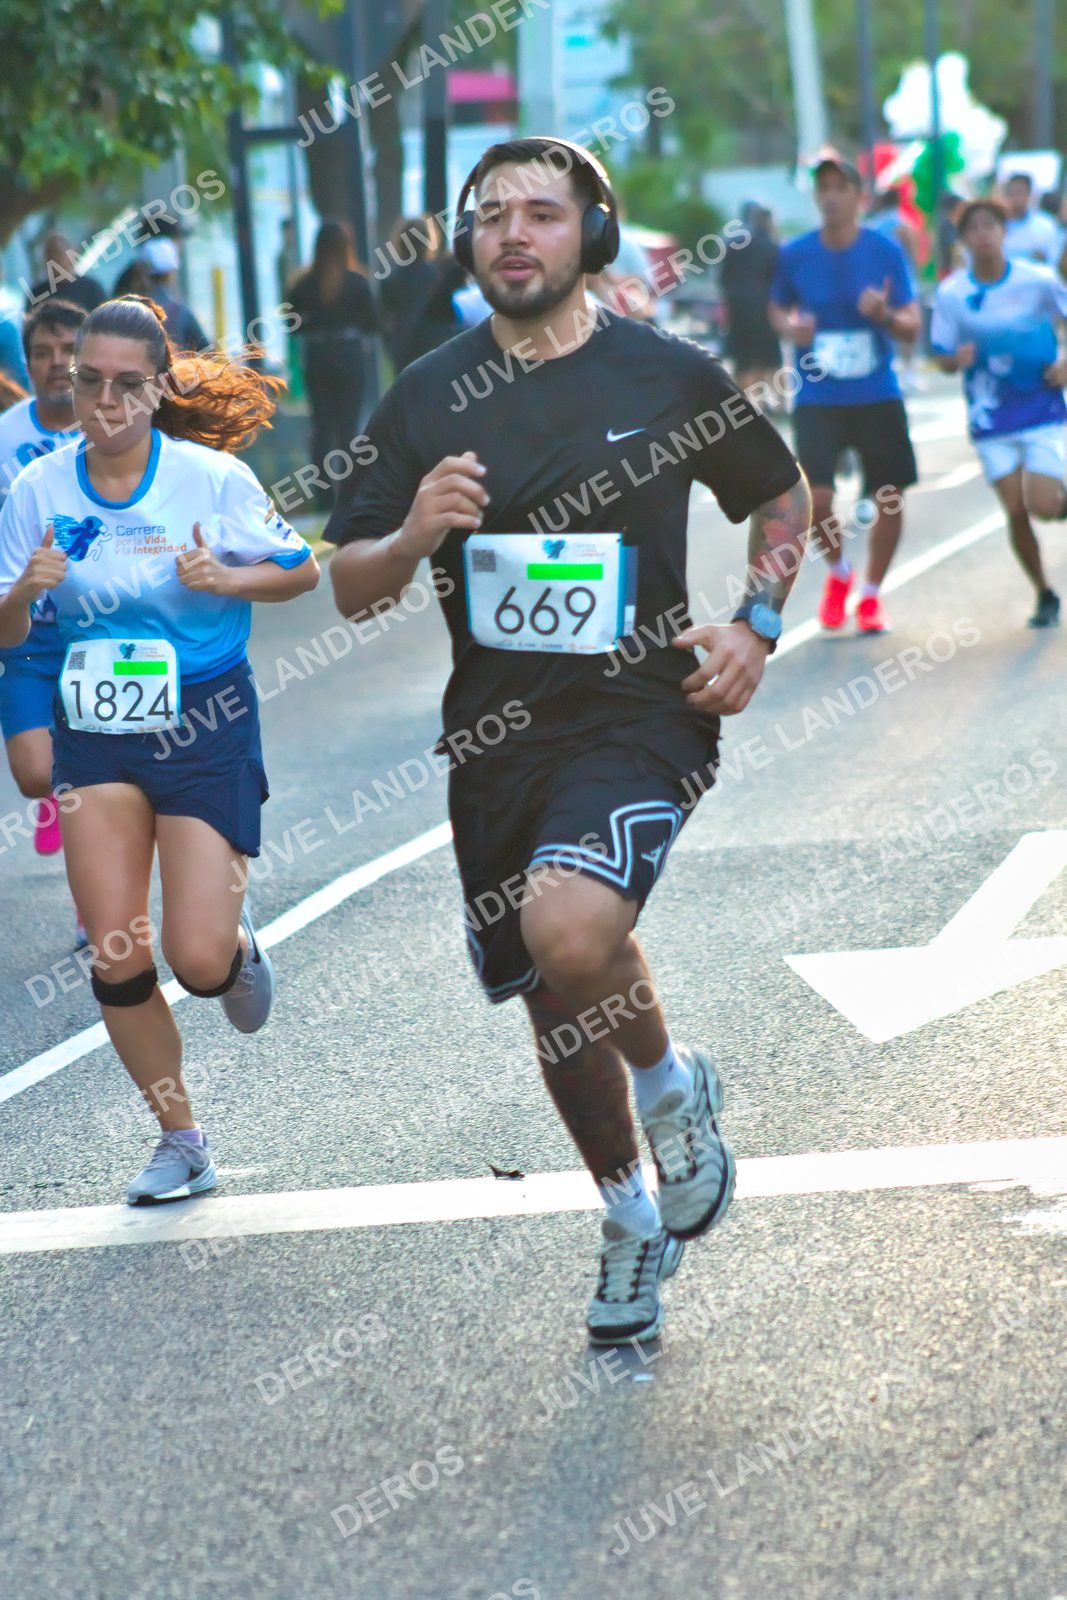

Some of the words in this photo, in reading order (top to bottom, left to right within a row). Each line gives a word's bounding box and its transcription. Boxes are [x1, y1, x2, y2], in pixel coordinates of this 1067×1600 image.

[116, 525, 166, 536] Carrera
[144, 534, 167, 545] Vida
[134, 543, 187, 555] Integridad
[494, 586, 596, 636] 669
[70, 680, 174, 722] 1824
